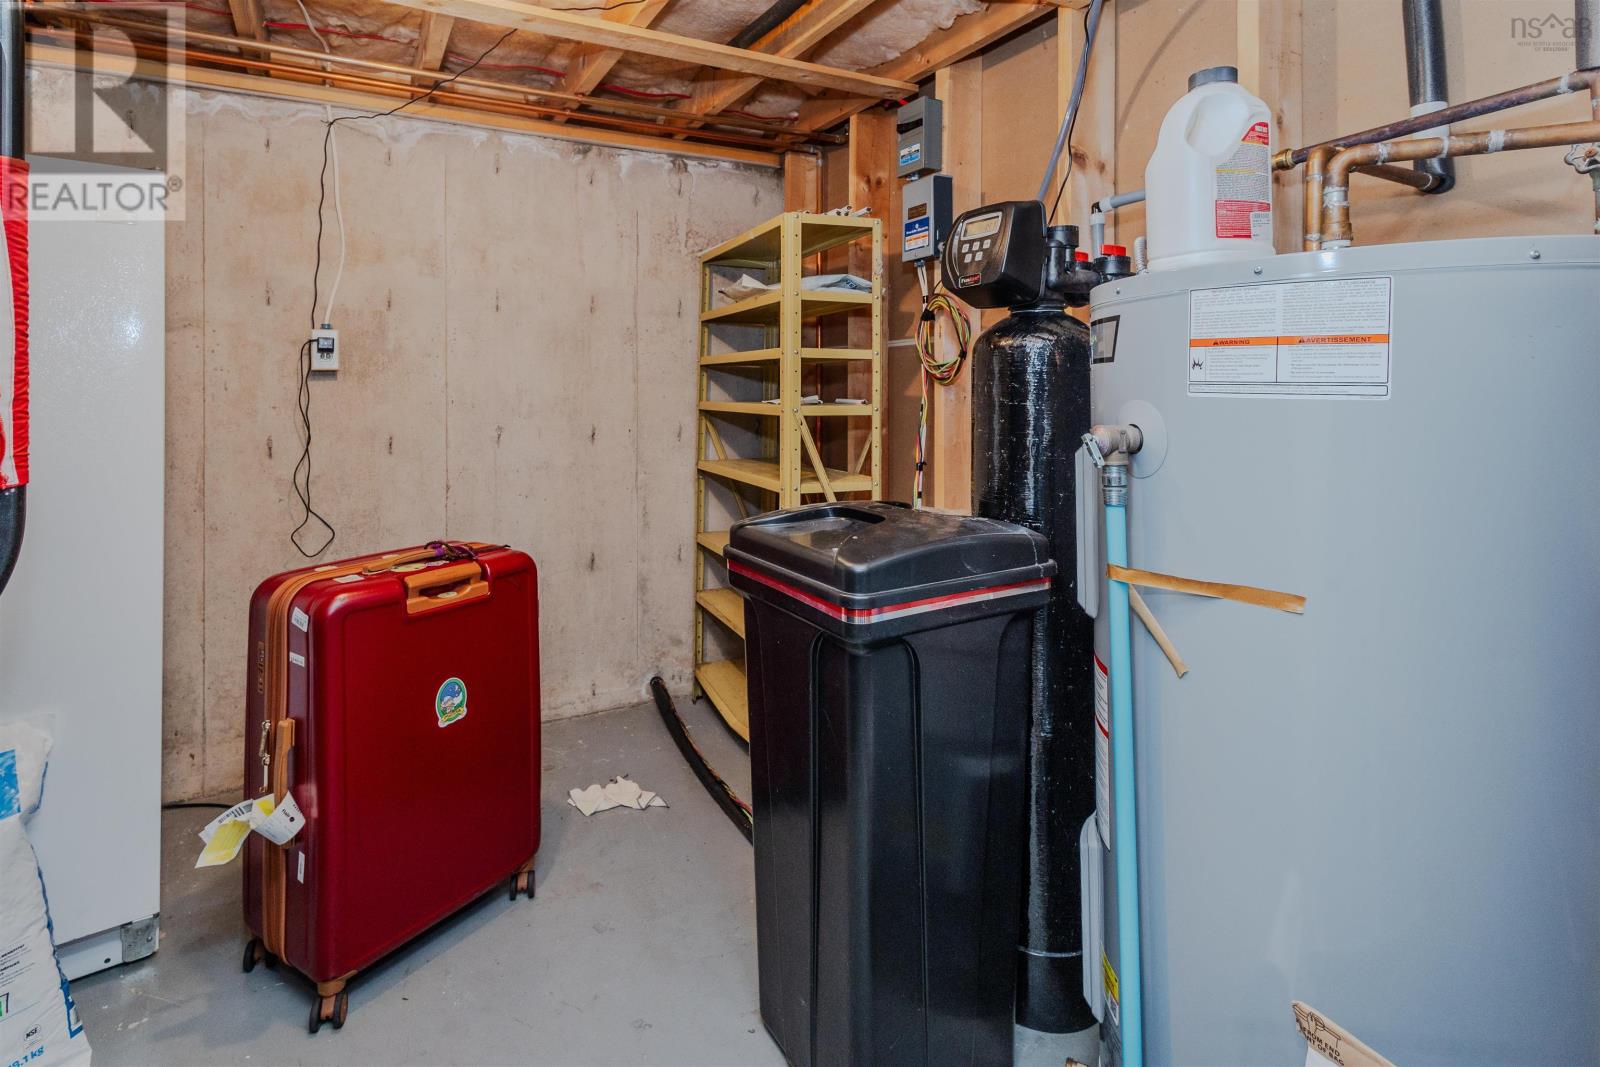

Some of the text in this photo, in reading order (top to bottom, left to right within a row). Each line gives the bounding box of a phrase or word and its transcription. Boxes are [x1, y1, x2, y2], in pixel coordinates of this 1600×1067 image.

[1219, 338, 1250, 346] WARNING
[1306, 336, 1372, 344] AVERTISSEMENT
[1324, 1042, 1341, 1057] END
